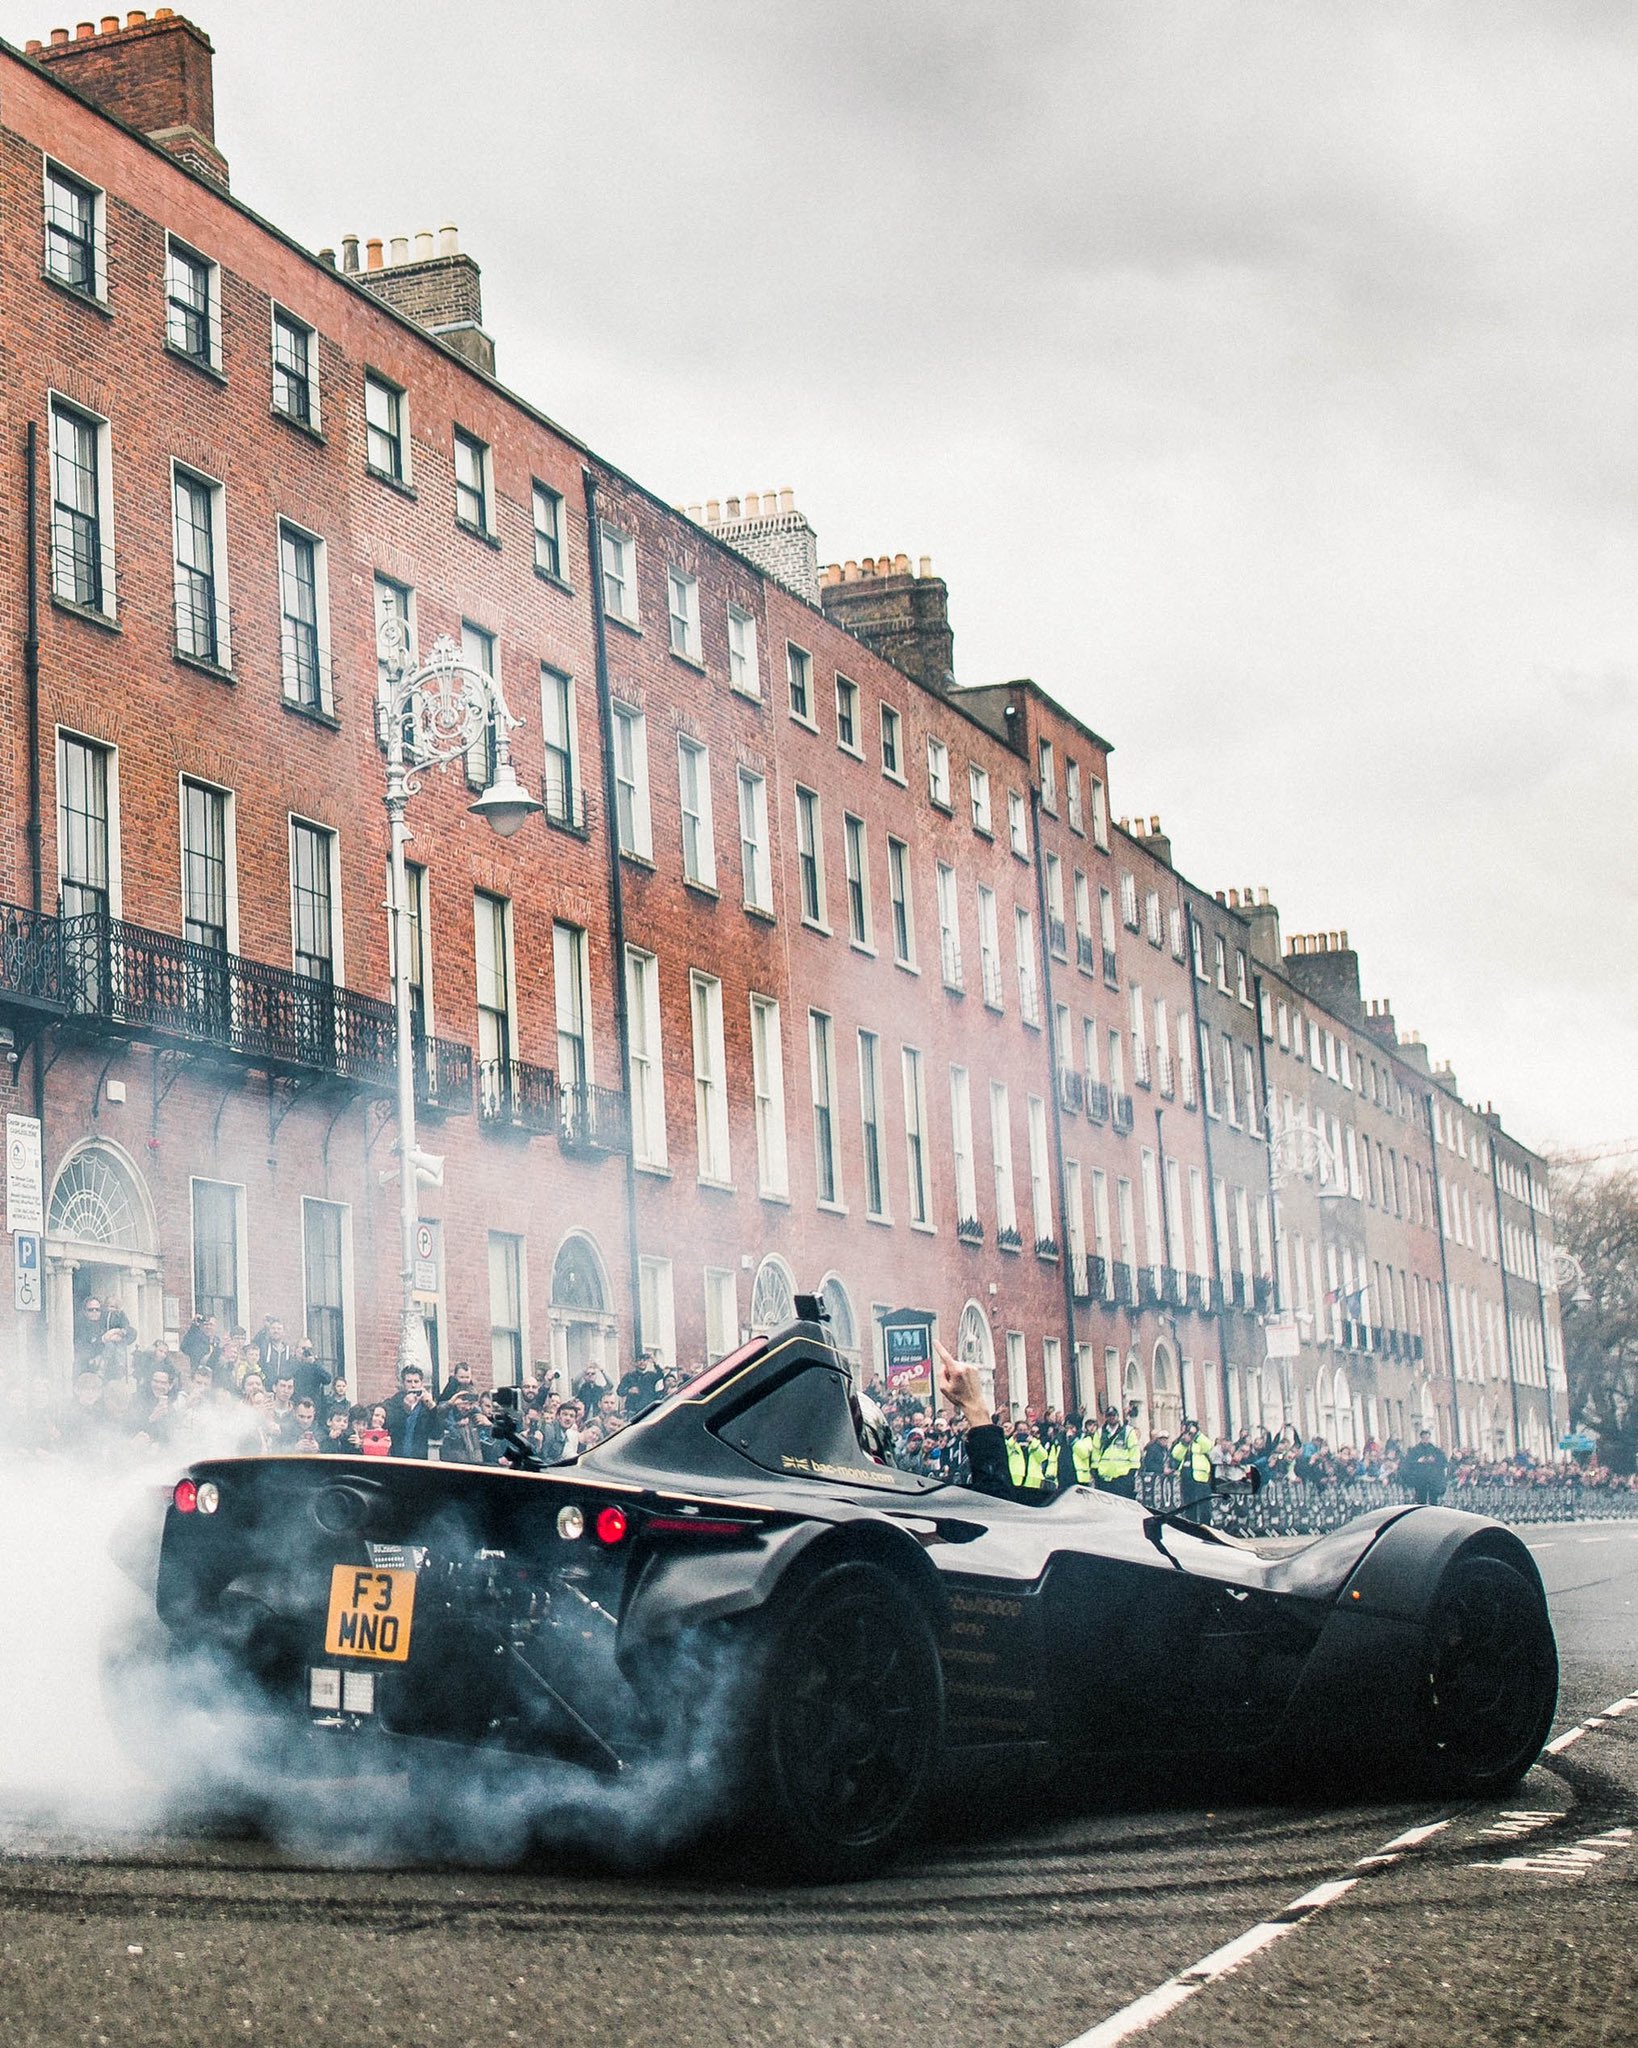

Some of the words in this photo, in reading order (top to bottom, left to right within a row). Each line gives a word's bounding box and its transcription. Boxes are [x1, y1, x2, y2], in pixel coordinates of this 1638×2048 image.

[22, 1240, 33, 1264] P
[891, 1364, 924, 1386] SOLD
[811, 1459, 896, 1484] bac-mono.com
[352, 1571, 393, 1612] F3
[338, 1611, 399, 1654] MNO
